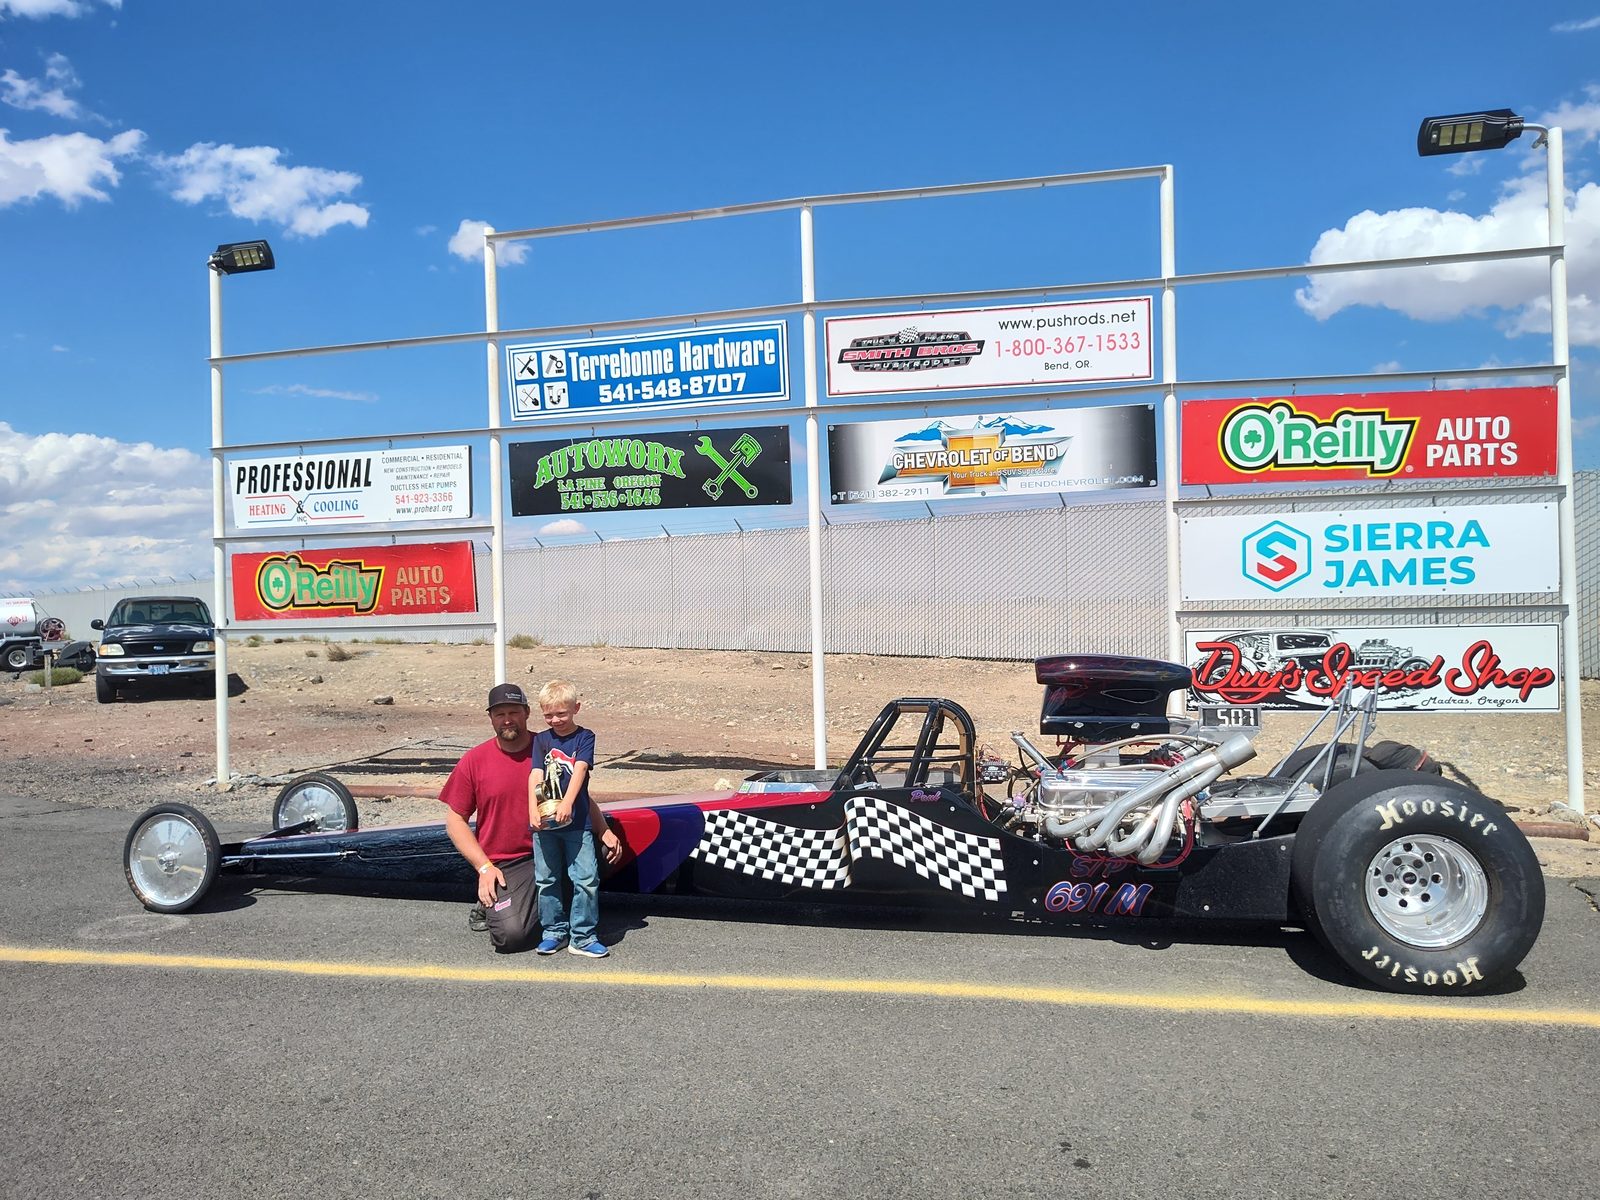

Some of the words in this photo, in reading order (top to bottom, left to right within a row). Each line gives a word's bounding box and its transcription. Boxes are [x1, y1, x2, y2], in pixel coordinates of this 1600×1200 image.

[998, 310, 1136, 331] www.pushrods.net
[843, 347, 912, 361] SMITH
[994, 332, 1141, 358] 1-800-367-1533
[569, 348, 674, 381] Terrebonne
[678, 337, 776, 372] Hardware
[873, 358, 951, 369] PUSHRODS
[1044, 362, 1072, 371] Bend,
[599, 374, 746, 403] 541-548-8707
[1230, 410, 1403, 465] O'Reilly
[1435, 415, 1509, 441] AUTO
[381, 455, 420, 464] COMMERCIAL
[425, 452, 463, 461] RESIDENTIAL
[534, 438, 687, 489] AUTOWORX
[893, 448, 991, 470] CHEVROLET
[993, 449, 1008, 462] OF
[1010, 444, 1058, 463] BEND
[1426, 441, 1518, 468] PARTS
[236, 458, 372, 495] PROFESSIONAL
[390, 483, 420, 492] DUCTLESS
[421, 482, 435, 490] HEAT
[557, 479, 575, 492] LA
[576, 477, 606, 491] PINE
[613, 474, 662, 489] OREGON
[952, 471, 972, 479] Your
[972, 469, 992, 478] Truck
[395, 492, 453, 505] 541-923-3366
[878, 487, 929, 498] 382-2911
[249, 503, 287, 516] HEATING
[296, 500, 305, 514] &
[313, 499, 360, 513] COOLING
[396, 504, 453, 514] www.proheat.org
[1323, 520, 1490, 553] SIERRA
[264, 561, 376, 608] O'Reilly
[396, 564, 445, 586] AUTO
[1322, 556, 1475, 589] JAMES
[391, 585, 452, 607] PARTS
[1304, 642, 1445, 703] Speed
[1443, 640, 1556, 703] Shop
[1420, 696, 1474, 706] Madras,
[1482, 695, 1519, 707] Oregon
[1374, 797, 1498, 836] Hoosier
[1044, 880, 1110, 913] 691
[1104, 882, 1154, 917] M
[1361, 945, 1485, 987] Hoosier
